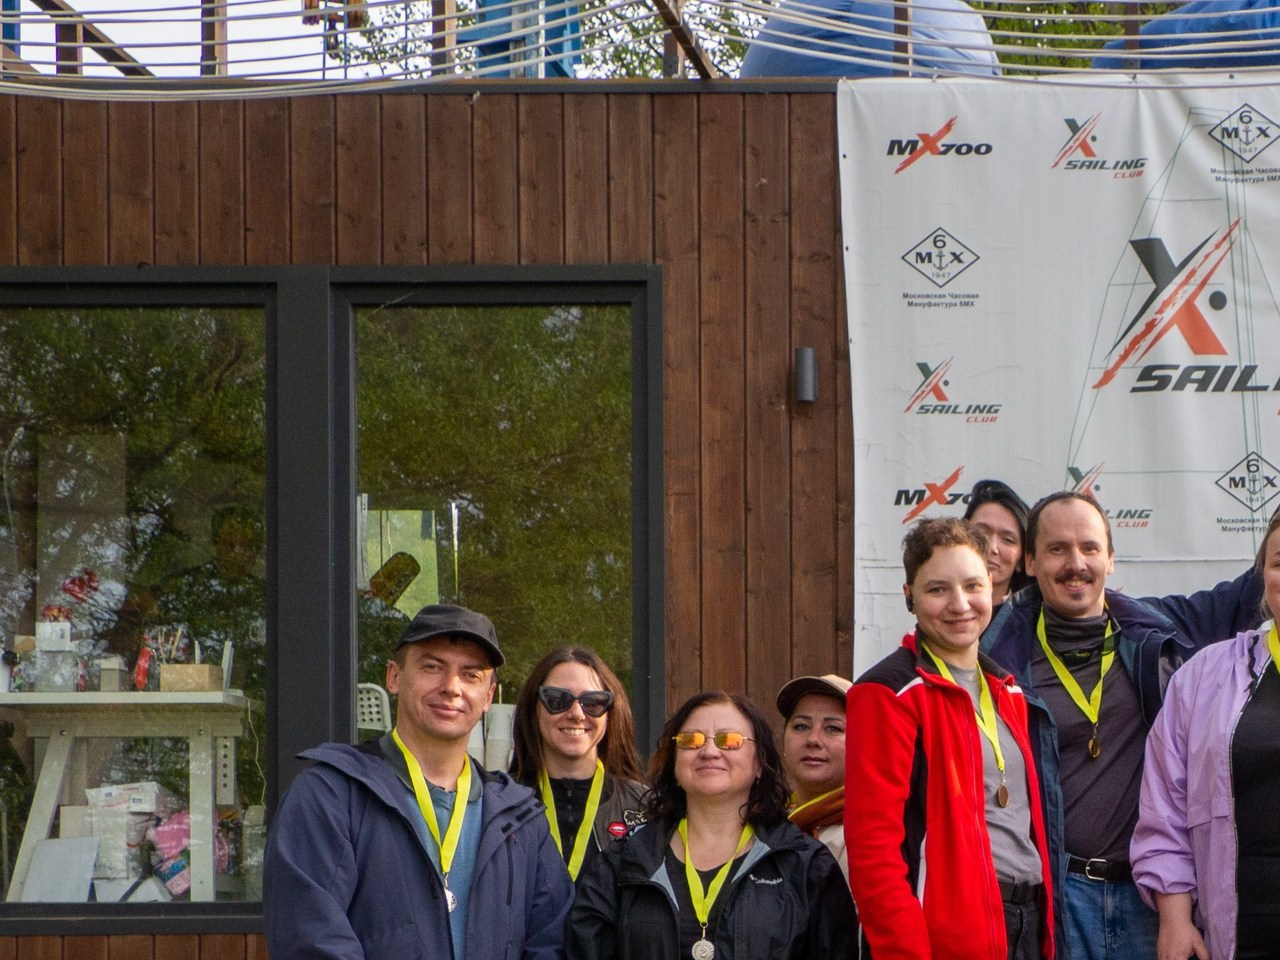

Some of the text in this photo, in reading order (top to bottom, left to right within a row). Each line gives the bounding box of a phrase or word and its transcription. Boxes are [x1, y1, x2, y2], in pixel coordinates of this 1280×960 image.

[1239, 110, 1252, 124] 6
[887, 115, 993, 175] MX700
[1064, 158, 1148, 170] SAILING
[1113, 170, 1144, 179] CLUB
[933, 234, 946, 249] 6
[902, 292, 947, 300] Московская
[907, 300, 958, 309] Мануфактура
[916, 404, 1002, 415] SAILING
[966, 415, 998, 423] CLUB
[1246, 458, 1260, 473] 6
[1105, 509, 1153, 519] LING
[1221, 526, 1268, 534] Мануфактур
